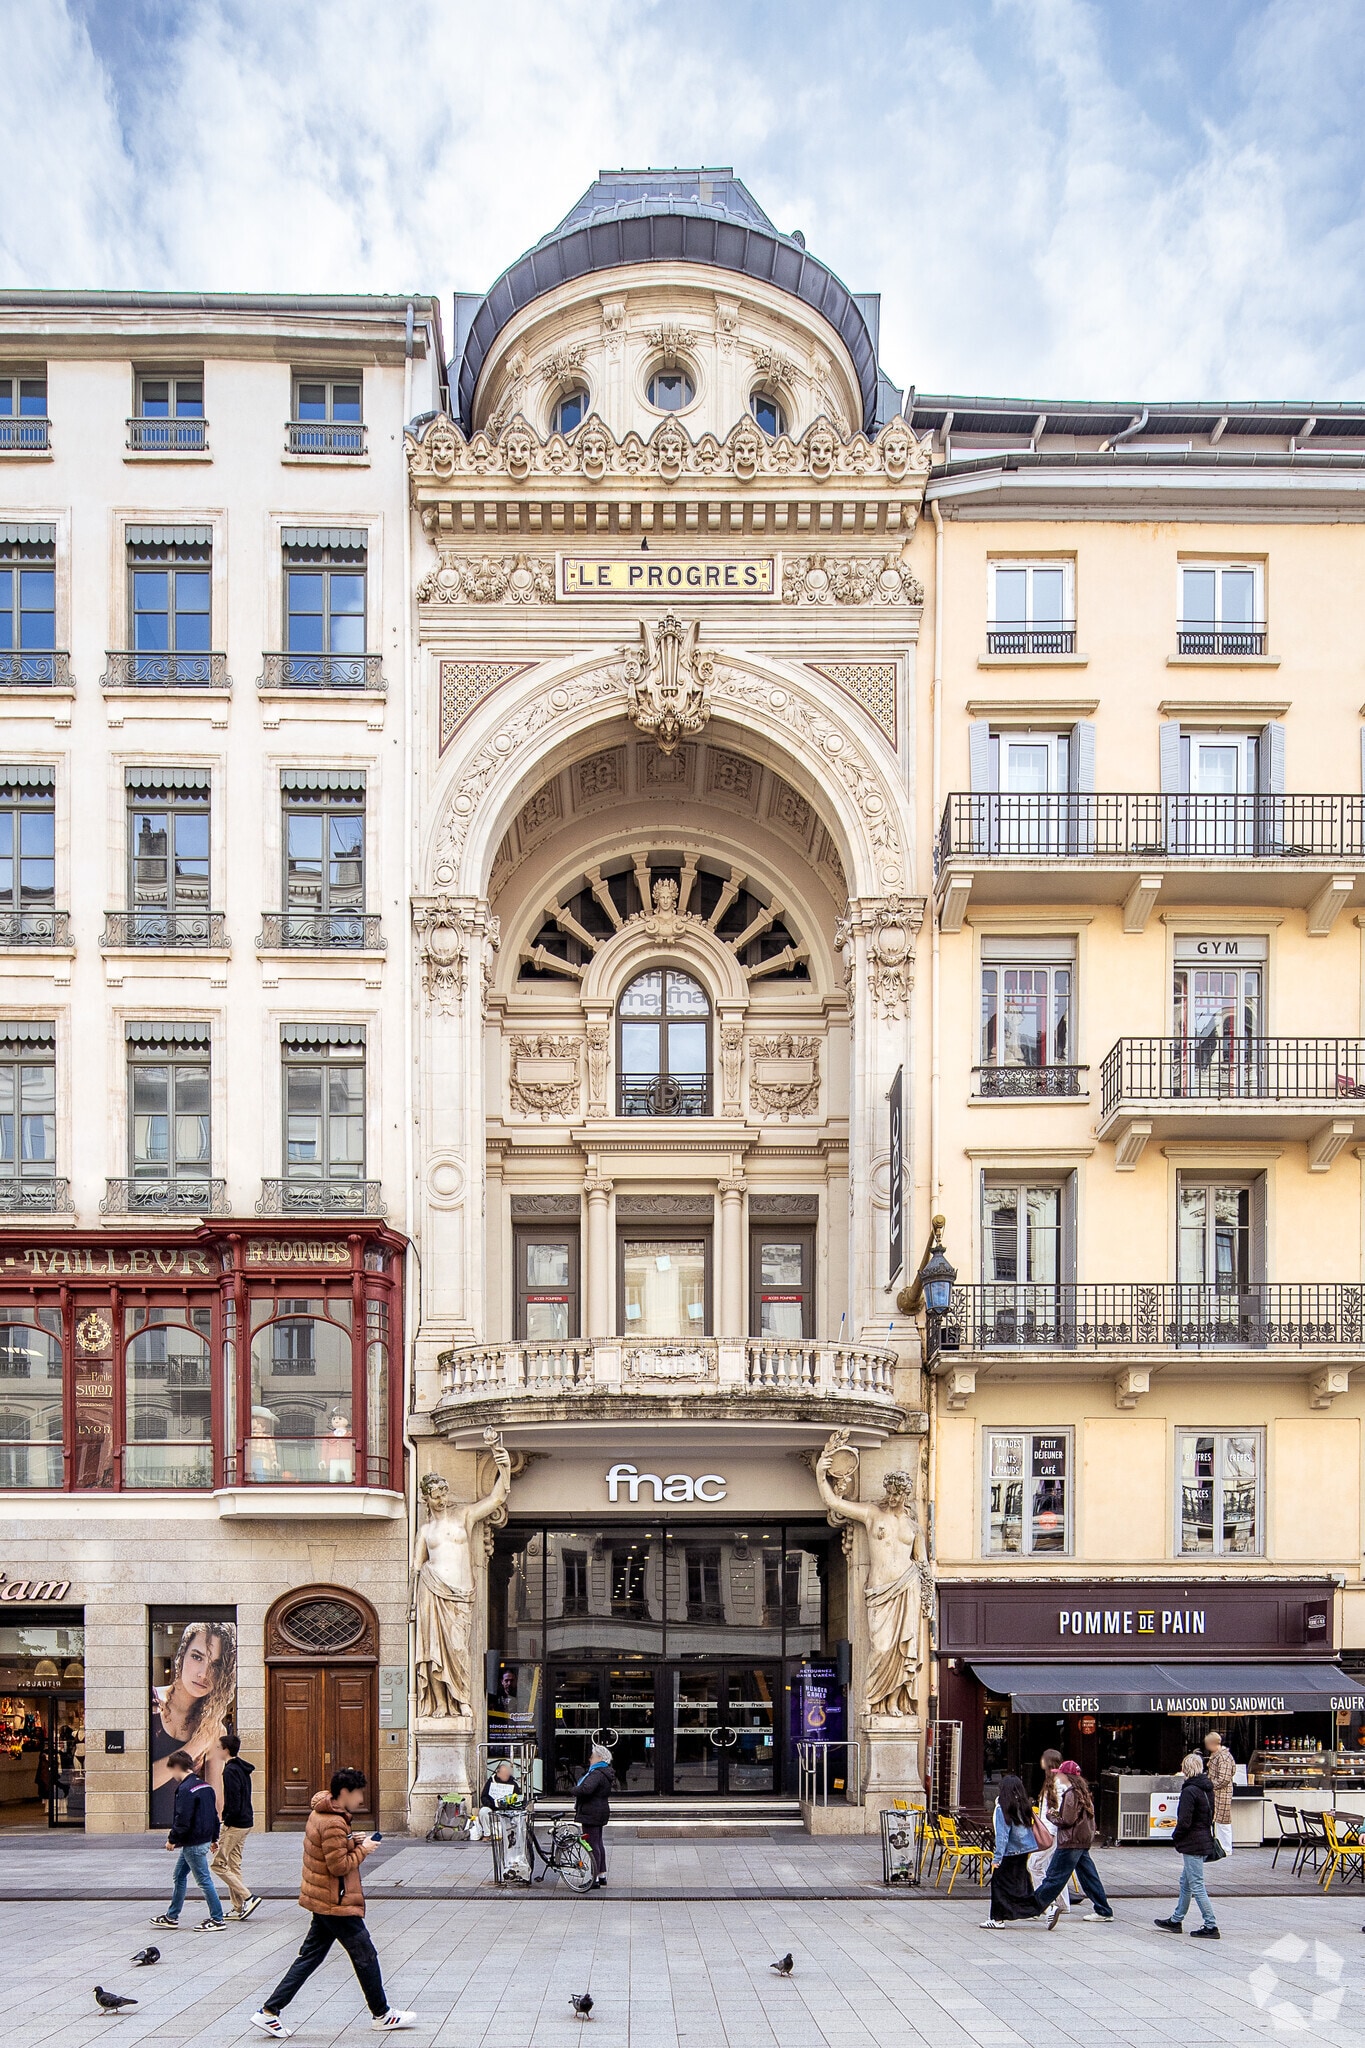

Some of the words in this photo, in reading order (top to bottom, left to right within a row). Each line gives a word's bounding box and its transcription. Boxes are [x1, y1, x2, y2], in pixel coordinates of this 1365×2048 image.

[579, 565, 612, 586] LE
[1197, 942, 1238, 954] GYM
[266, 1241, 351, 1263] HOMMES
[994, 1440, 1021, 1449] SALADES
[1040, 1440, 1057, 1448] PETIT
[998, 1455, 1017, 1464] PLATS
[1034, 1449, 1063, 1459] DÉJEUNER
[995, 1465, 1020, 1475] CHAUDS
[1040, 1465, 1056, 1475] CAFÉ
[605, 1463, 727, 1502] fnac
[1059, 1611, 1133, 1634] POMME
[1139, 1614, 1154, 1630] DE
[1161, 1610, 1205, 1634] PAIN
[384, 1672, 403, 1685] 83
[1062, 1695, 1100, 1711] CRÊPES
[1150, 1698, 1163, 1711] LA
[1167, 1698, 1208, 1711] MAISON
[1211, 1698, 1226, 1711] DU
[1230, 1697, 1285, 1711] SANDWICH
